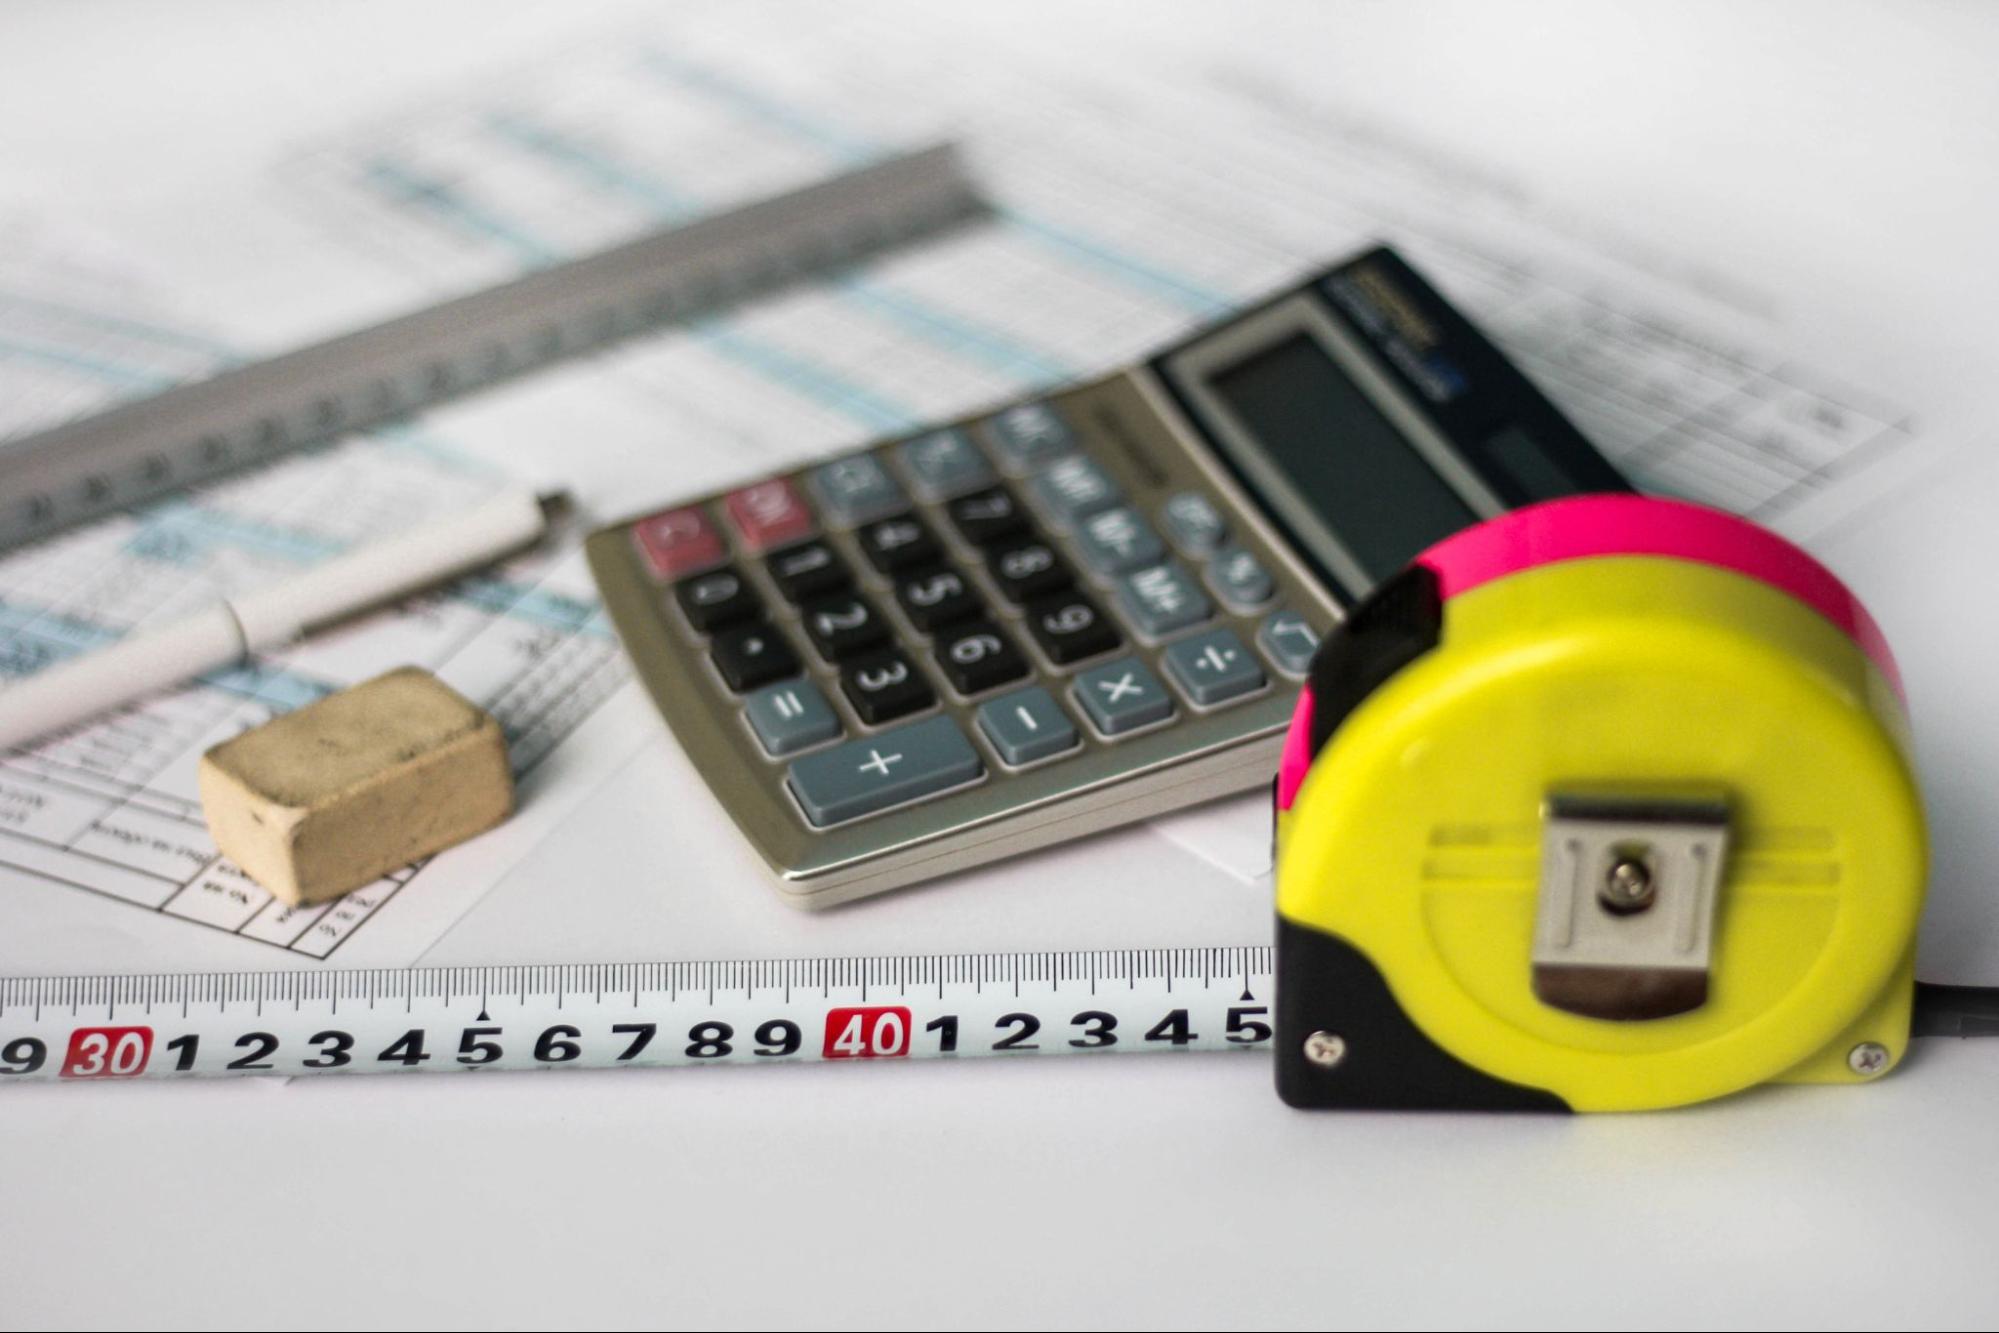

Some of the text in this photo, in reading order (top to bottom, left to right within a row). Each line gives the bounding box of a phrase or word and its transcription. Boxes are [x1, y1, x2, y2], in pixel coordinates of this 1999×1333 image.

[961, 496, 1011, 520] 7
[874, 520, 921, 550] 4
[782, 546, 830, 577] 1
[1001, 546, 1053, 579] 8
[694, 573, 740, 605] 0
[908, 573, 963, 606] 5
[1129, 566, 1183, 613] M+
[814, 601, 869, 635] 2
[1043, 604, 1094, 635] 9
[950, 633, 1002, 664] 6
[856, 660, 908, 690] 3
[0, 1006, 1273, 1076] 9 30 1 2 3 4 5 6 7 8 9 40 1 2 3 4 5
